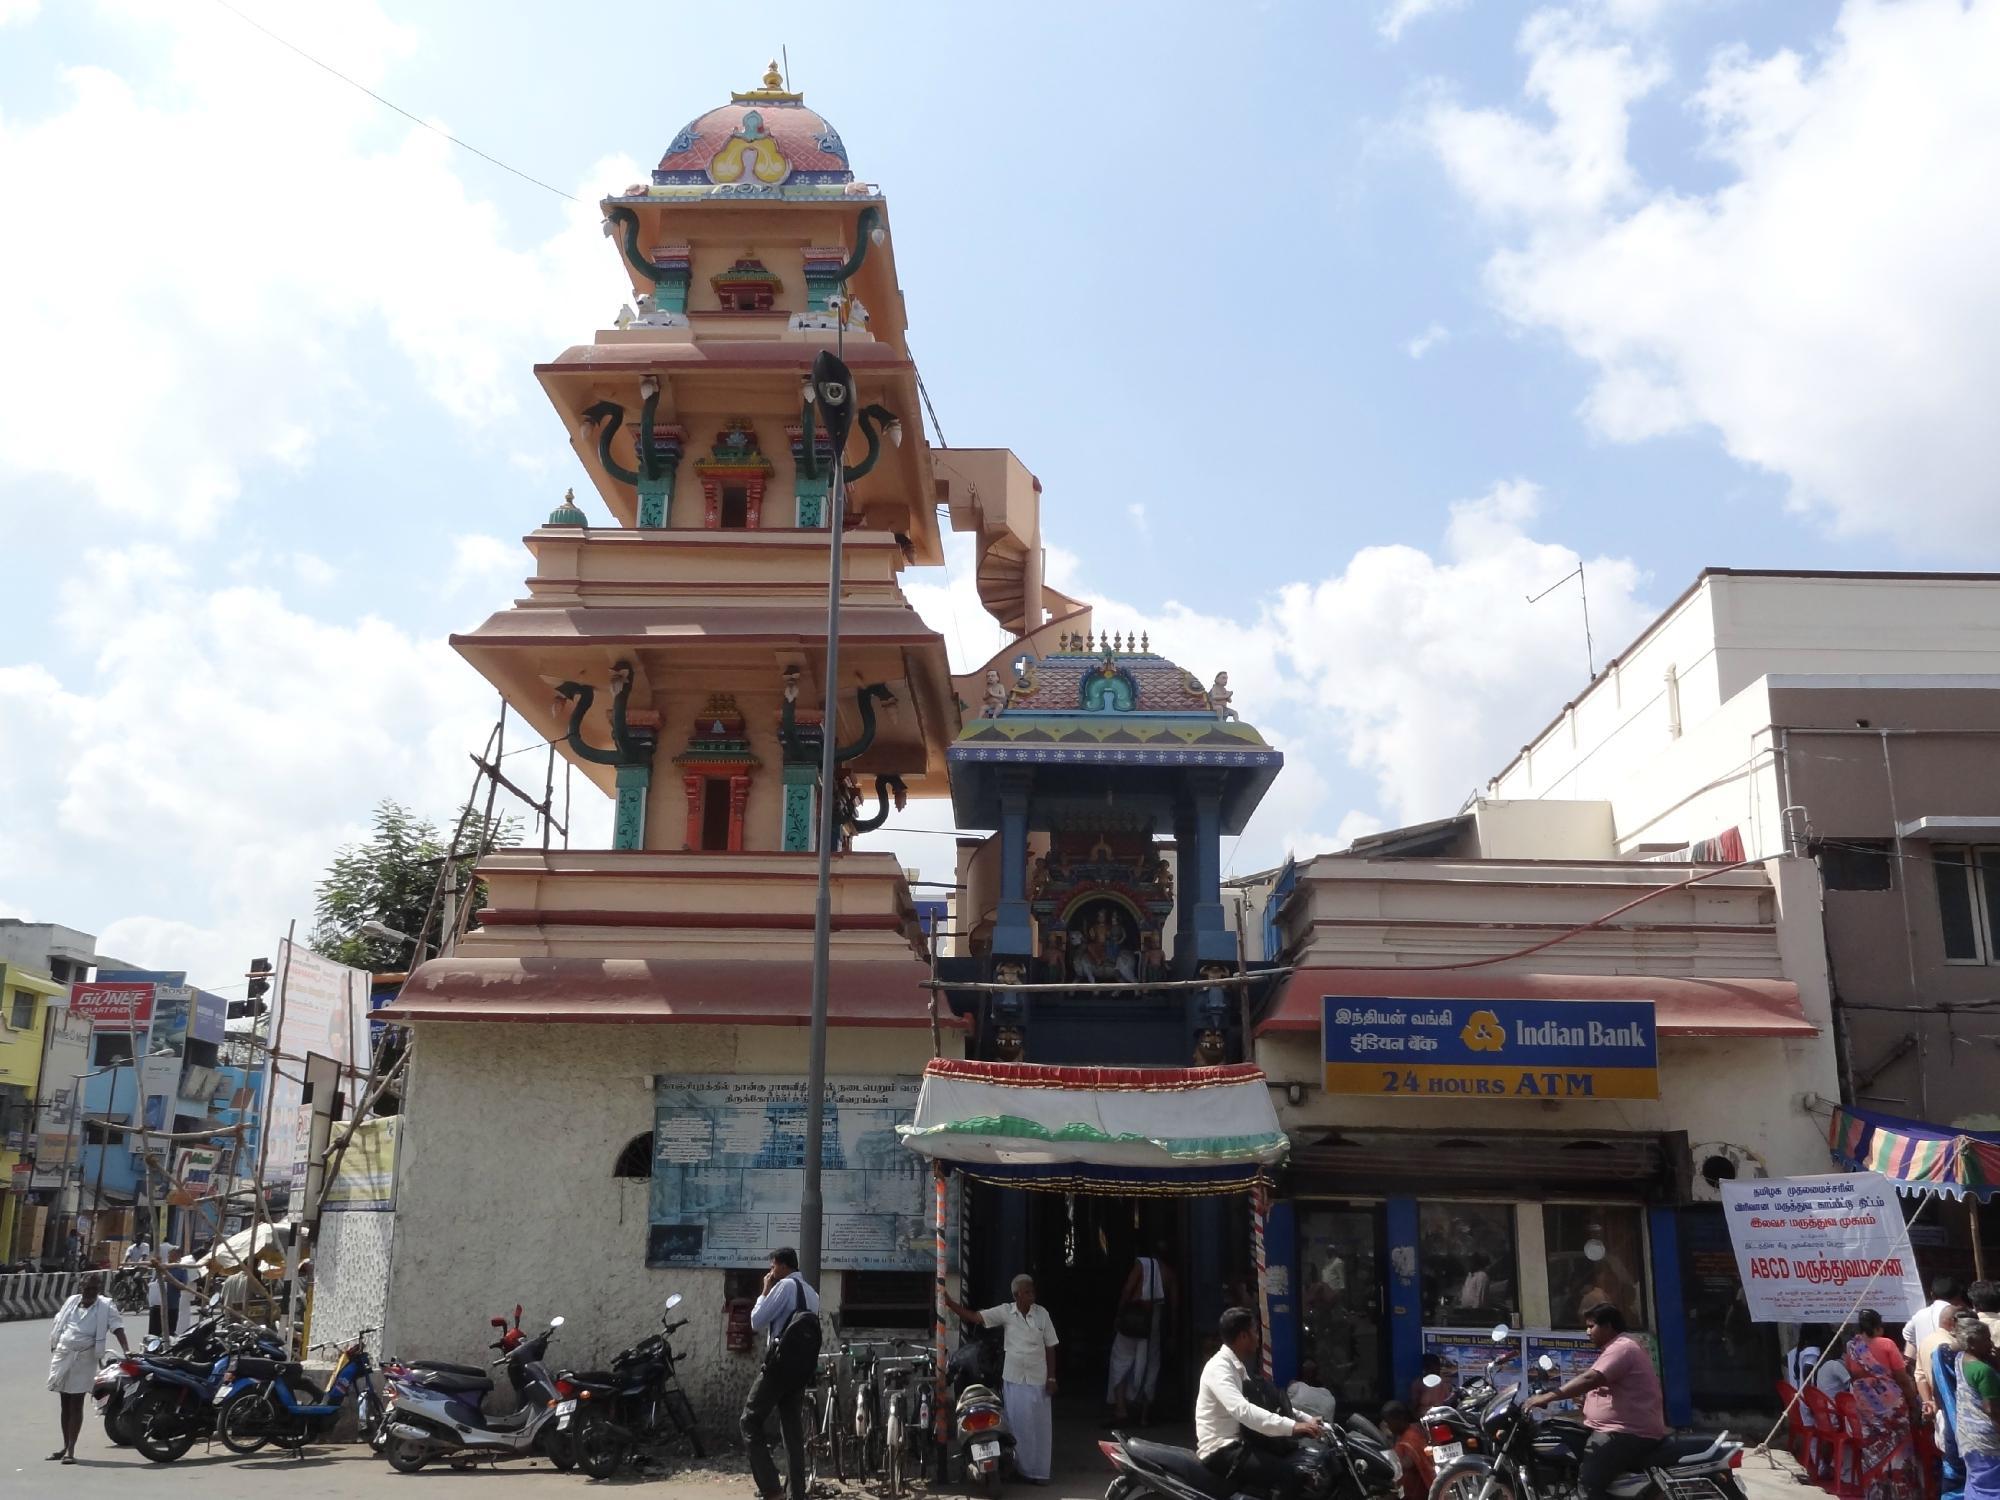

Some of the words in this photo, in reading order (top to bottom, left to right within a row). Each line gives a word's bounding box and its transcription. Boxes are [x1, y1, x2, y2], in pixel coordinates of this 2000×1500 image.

[1334, 1007, 1407, 1027] இந்தியன்
[1410, 1008, 1453, 1026] வங்கி
[1350, 1033, 1404, 1053] इंडियन
[1516, 1019, 1585, 1047] Indian
[1588, 1020, 1647, 1048] Bank
[1381, 1070, 1421, 1093] 24
[1428, 1077, 1506, 1095] HOURS
[1514, 1072, 1595, 1097] ATM
[1753, 1186, 1782, 1198] தமிழக
[1787, 1181, 1855, 1198] முதலமைச்சரின்
[1774, 1199, 1813, 1213] மருத்துவ
[1858, 1195, 1885, 1208] திட்டம்
[1750, 1216, 1787, 1229] இலவச
[1789, 1215, 1837, 1230] மருத்துவ
[1839, 1212, 1876, 1229] முகாம்
[1750, 1257, 1790, 1279] ABCD
[1793, 1250, 1904, 1286] மருத்துவமனை
